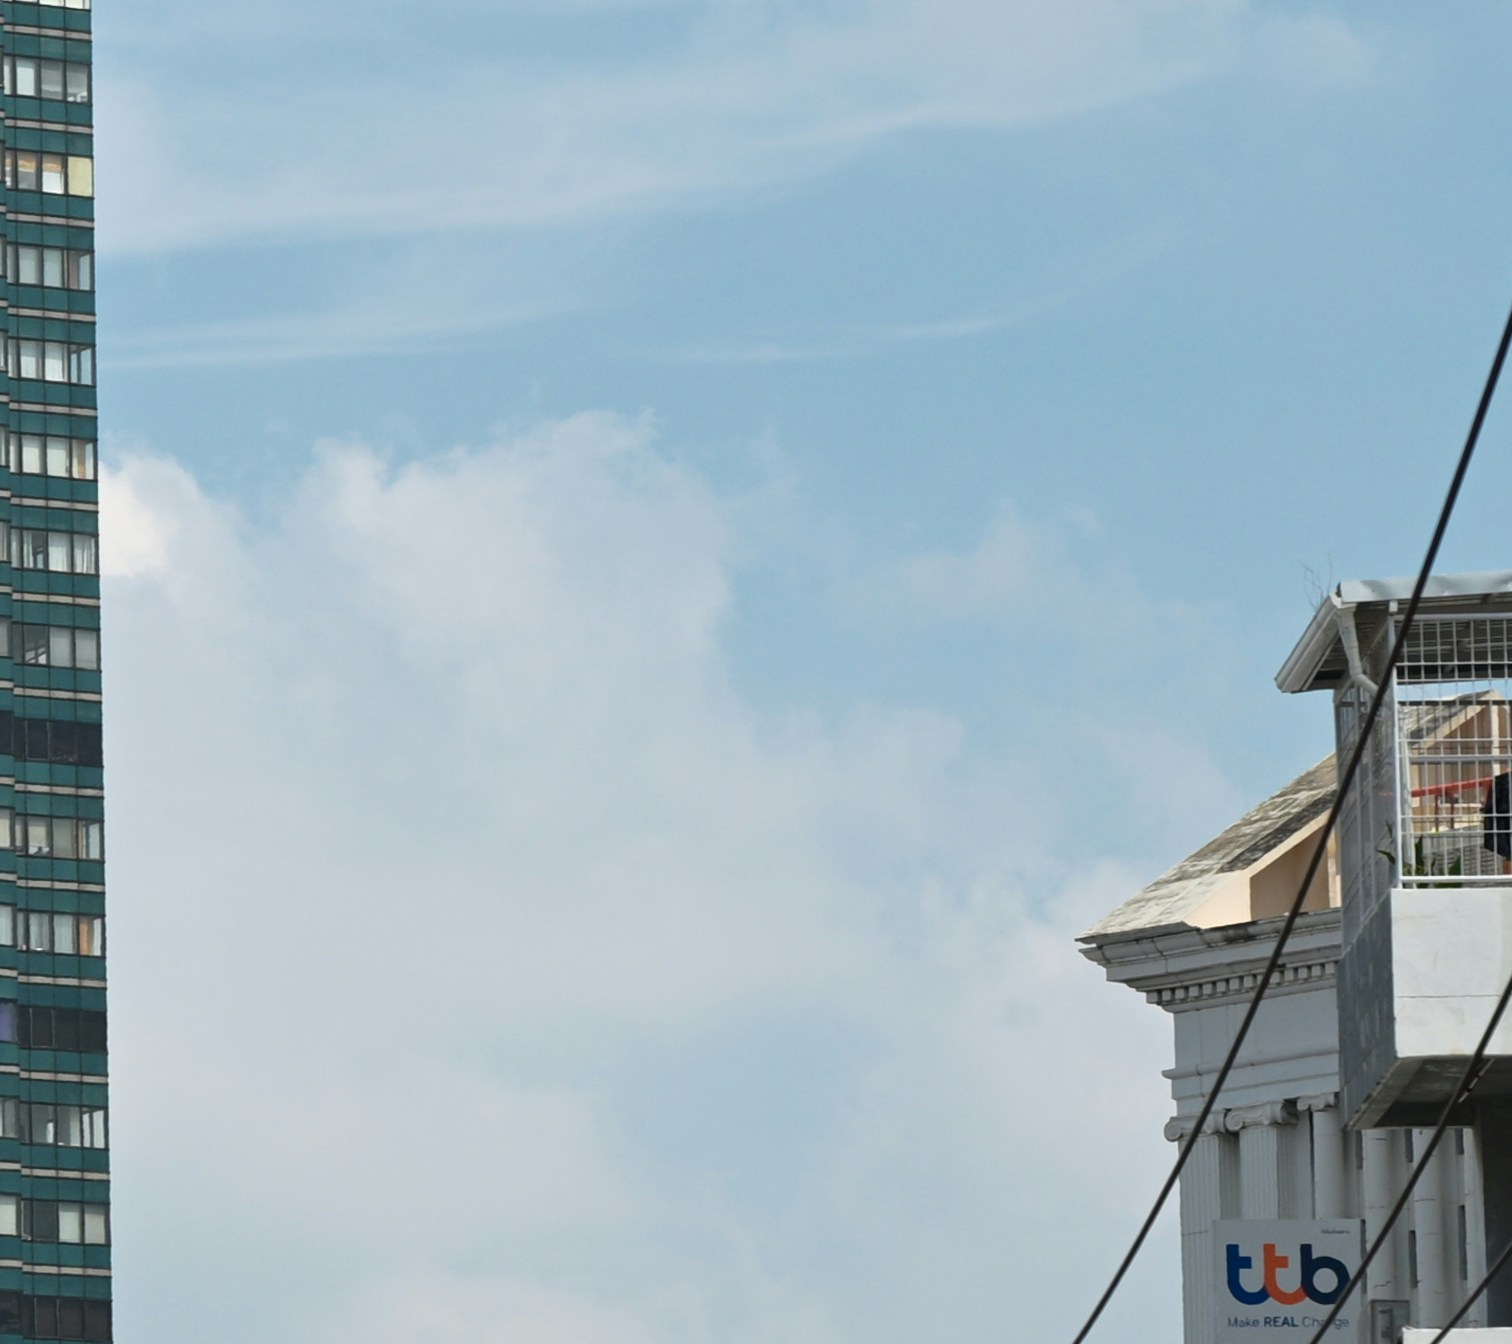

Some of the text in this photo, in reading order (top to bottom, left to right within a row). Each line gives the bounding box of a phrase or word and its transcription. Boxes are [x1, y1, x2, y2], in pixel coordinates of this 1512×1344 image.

[1226, 1243, 1352, 1306] ttb
[1227, 1316, 1260, 1328] Make
[1263, 1316, 1299, 1328] REAL
